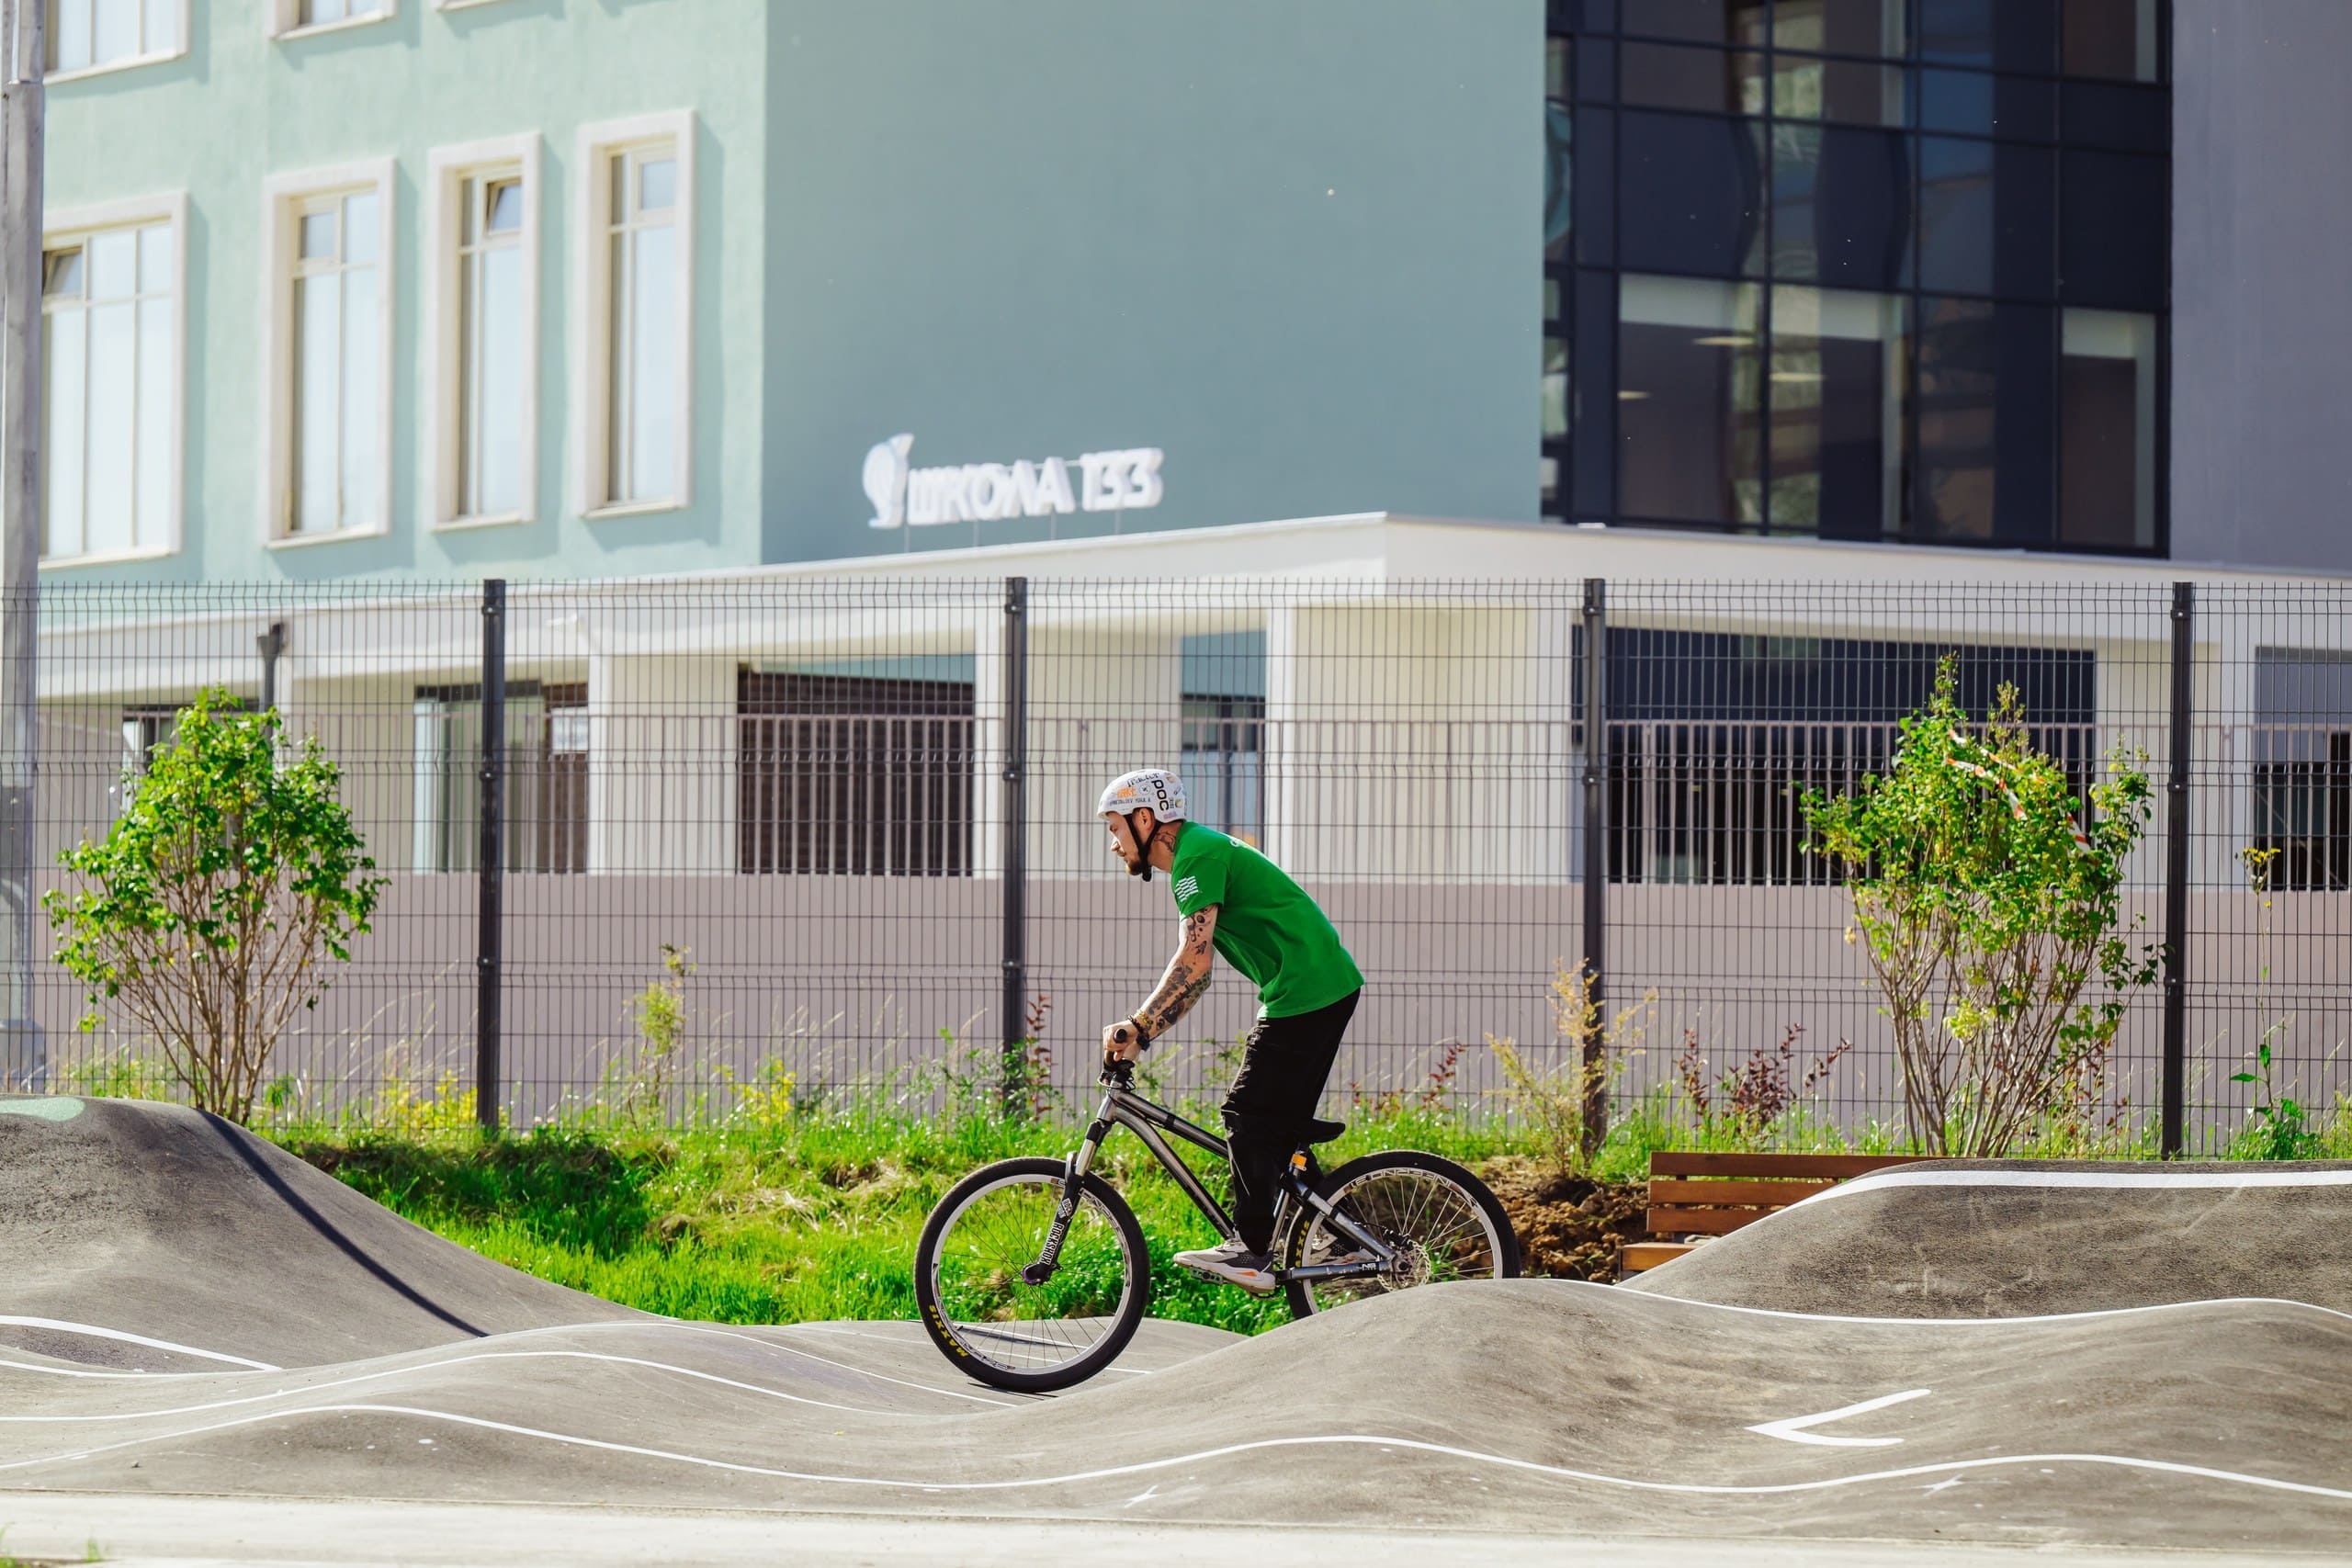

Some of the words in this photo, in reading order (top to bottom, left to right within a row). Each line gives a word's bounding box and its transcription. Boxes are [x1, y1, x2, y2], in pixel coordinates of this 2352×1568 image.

[907, 457, 1076, 525] ШКОЛА
[1080, 447, 1164, 512] 133
[1040, 1222, 1065, 1265] ROCKSHOX
[1295, 1220, 1310, 1283] AXXIS
[929, 1304, 969, 1358] MAXXIS
